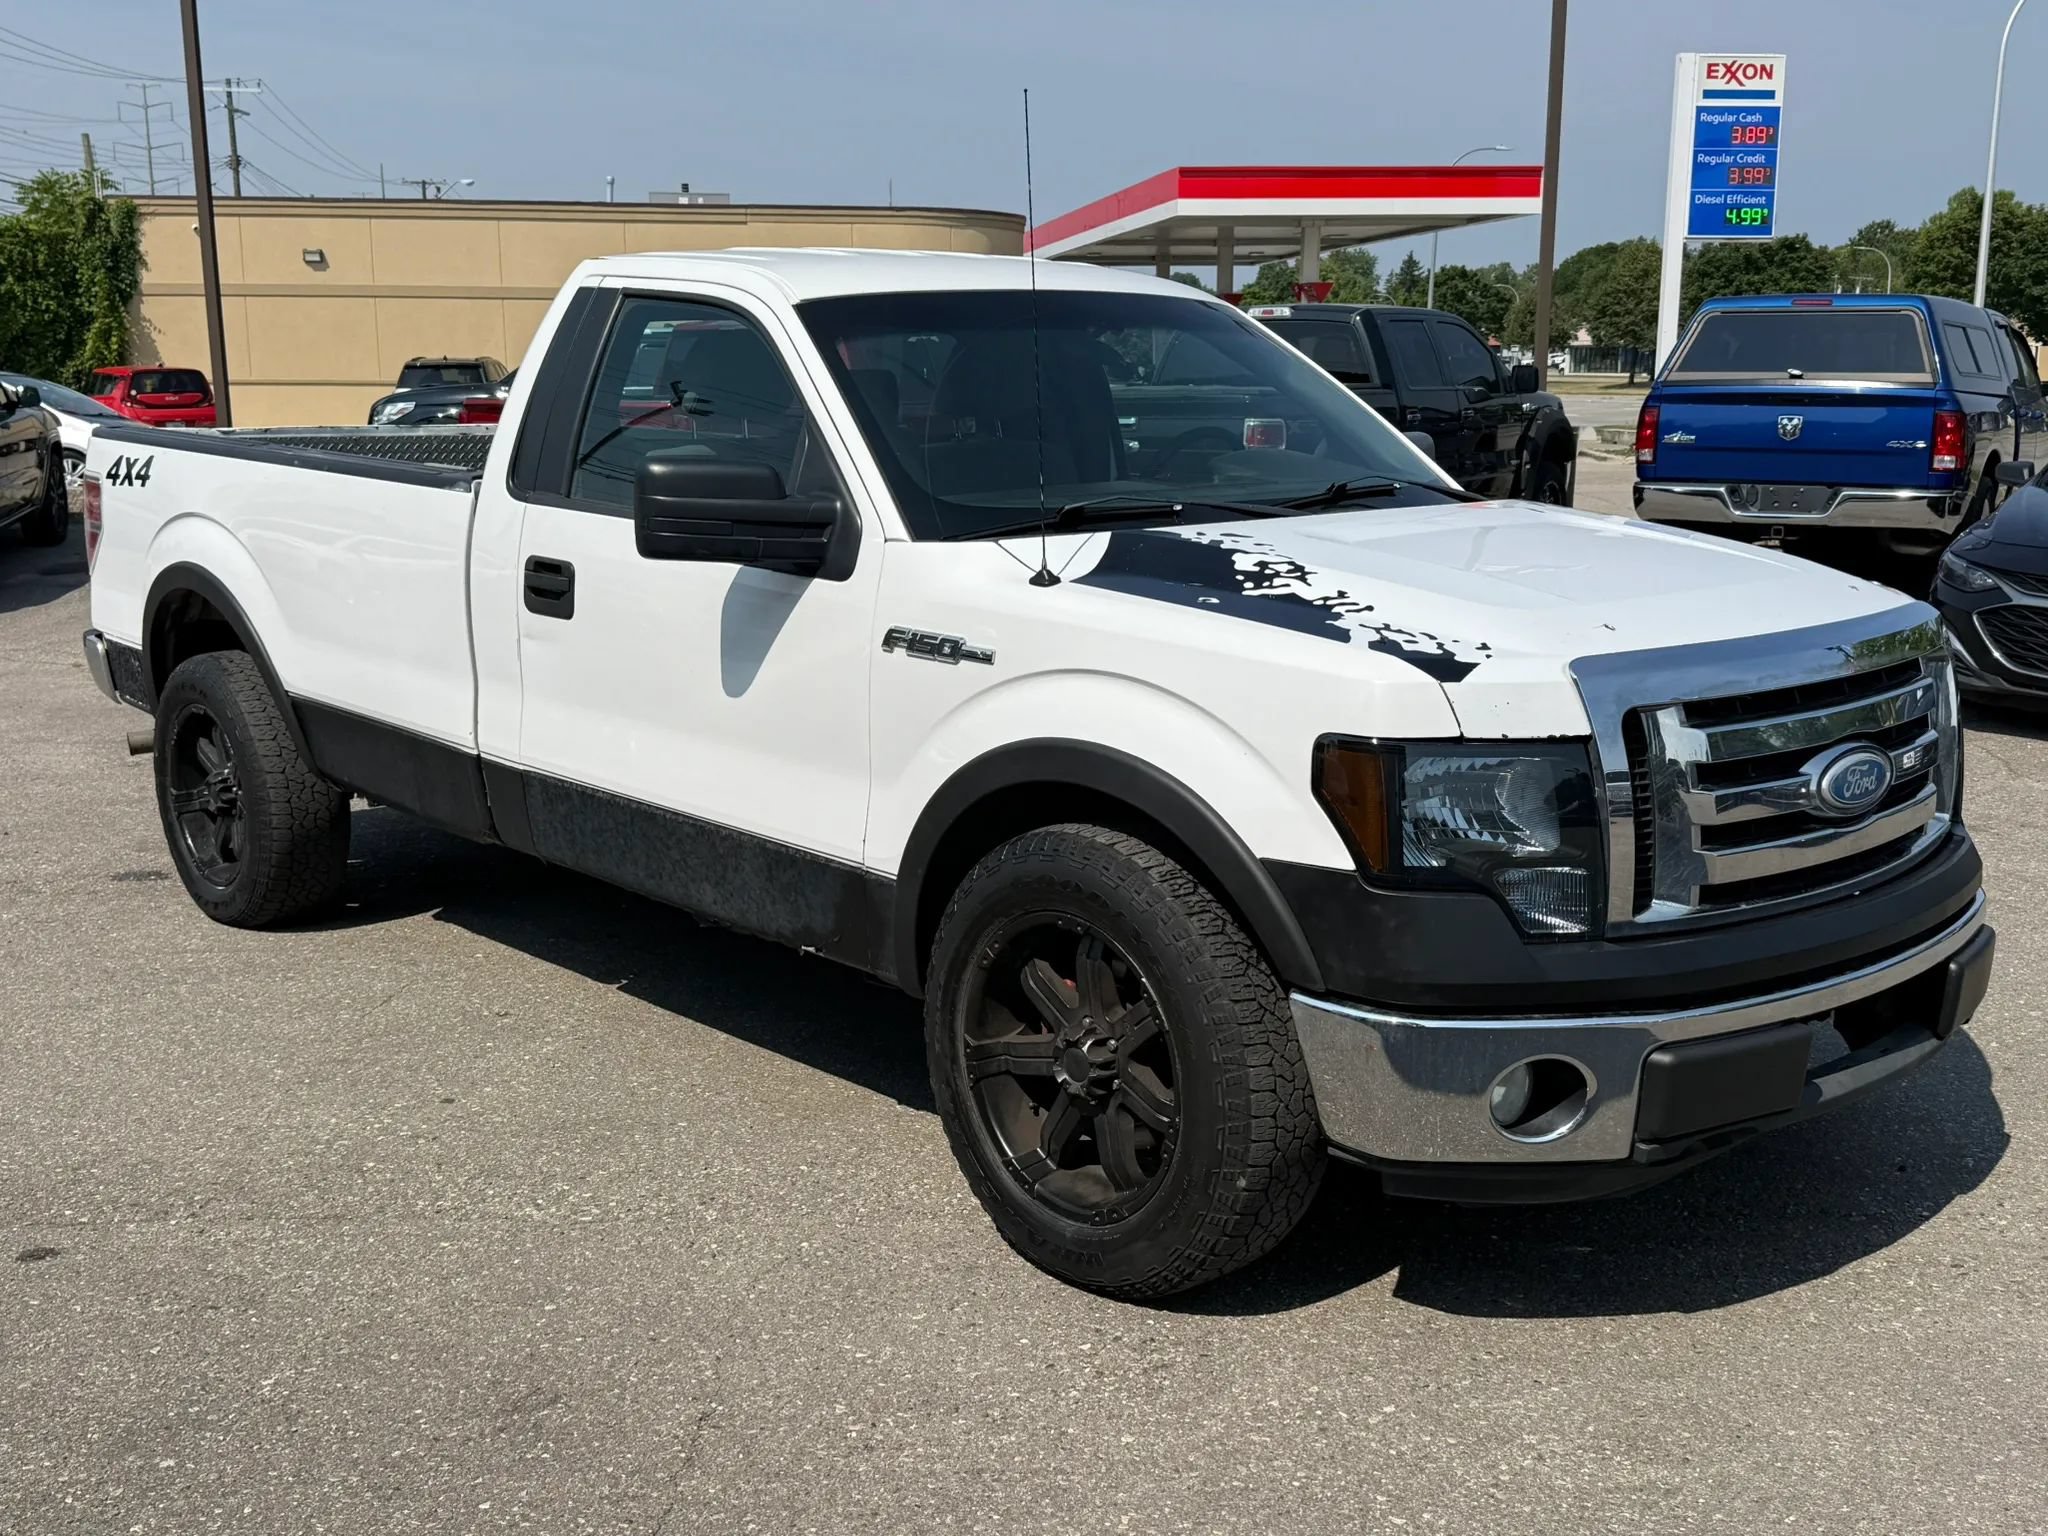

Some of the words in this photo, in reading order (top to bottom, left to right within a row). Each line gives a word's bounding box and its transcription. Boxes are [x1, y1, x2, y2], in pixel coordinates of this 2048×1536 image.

[1706, 60, 1774, 87] EXXON
[1700, 112, 1737, 125] Regular
[1739, 112, 1762, 123] Cash
[1697, 153, 1735, 166] Regular
[1736, 153, 1766, 163] Credit
[1695, 194, 1725, 205] Diesel
[1726, 194, 1766, 205] Efficient
[105, 454, 155, 488] 4X4
[1843, 764, 1877, 798] Ford
